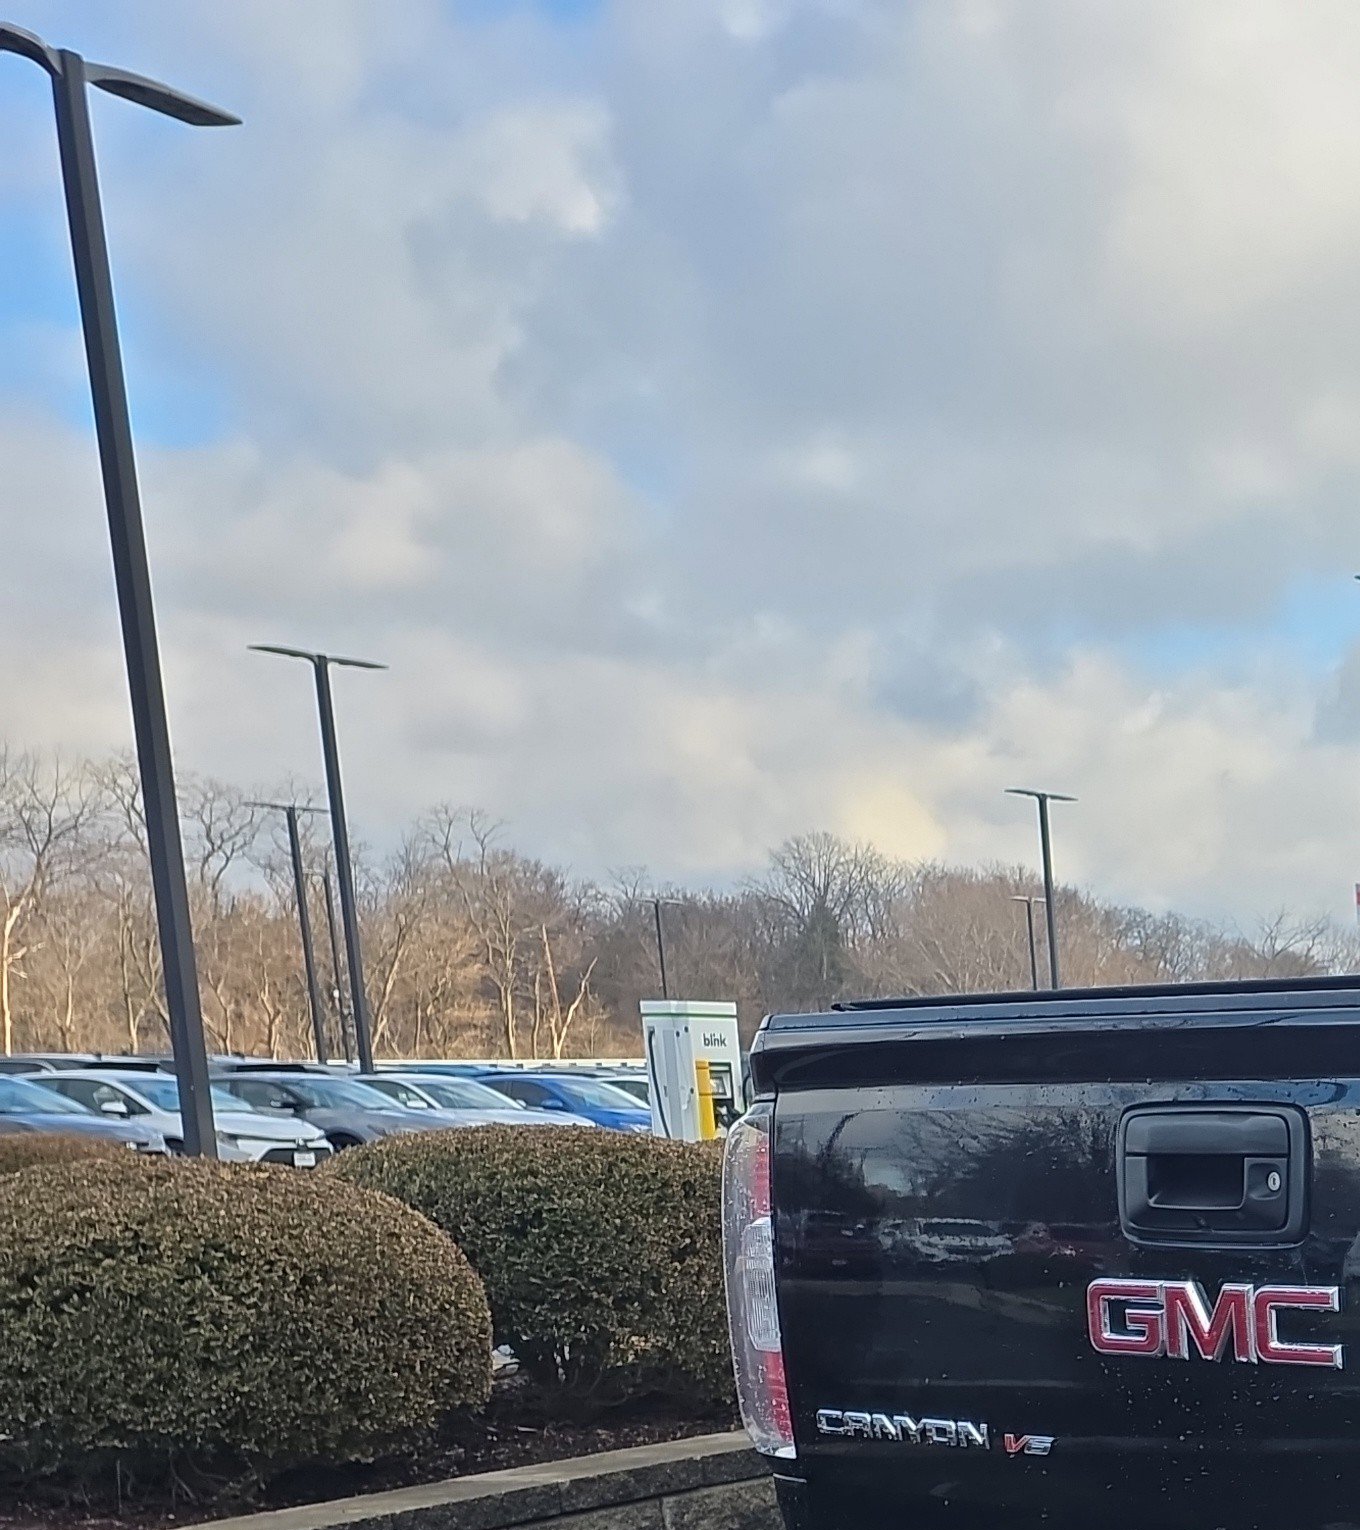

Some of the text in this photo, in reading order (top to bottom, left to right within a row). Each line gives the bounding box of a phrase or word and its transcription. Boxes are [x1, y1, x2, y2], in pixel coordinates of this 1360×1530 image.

[703, 1032, 727, 1047] blink
[1087, 1278, 1343, 1369] GMC
[816, 1408, 1057, 1456] CANYON V6
